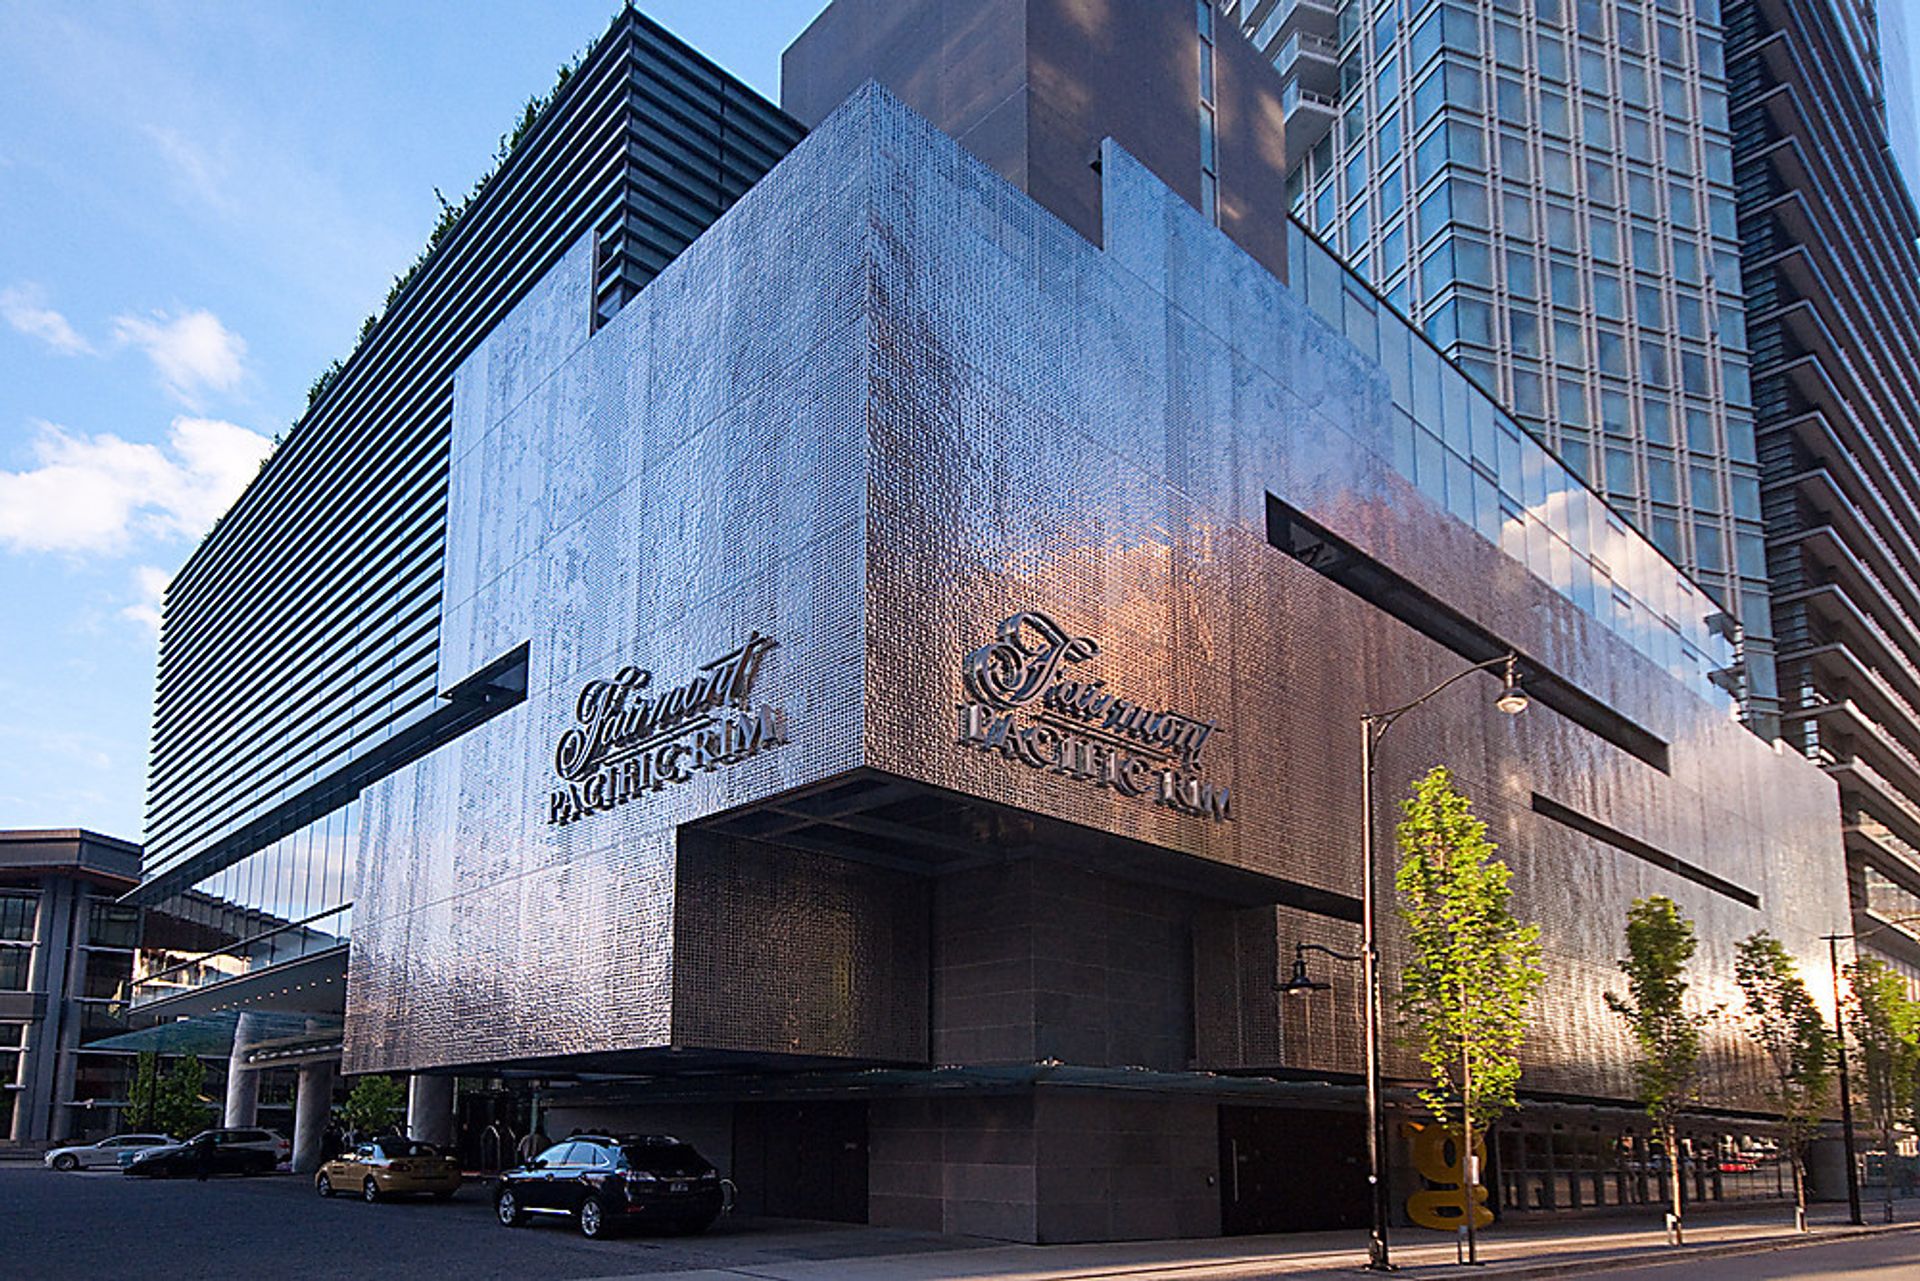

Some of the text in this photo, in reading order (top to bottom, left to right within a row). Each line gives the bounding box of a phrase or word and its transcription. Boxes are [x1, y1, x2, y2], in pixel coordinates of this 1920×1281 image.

[555, 630, 780, 783] Fairmont
[964, 611, 1224, 770] Fairmont
[548, 703, 790, 826] PACIFIC RIM
[956, 700, 1234, 822] PACIFIC RIM
